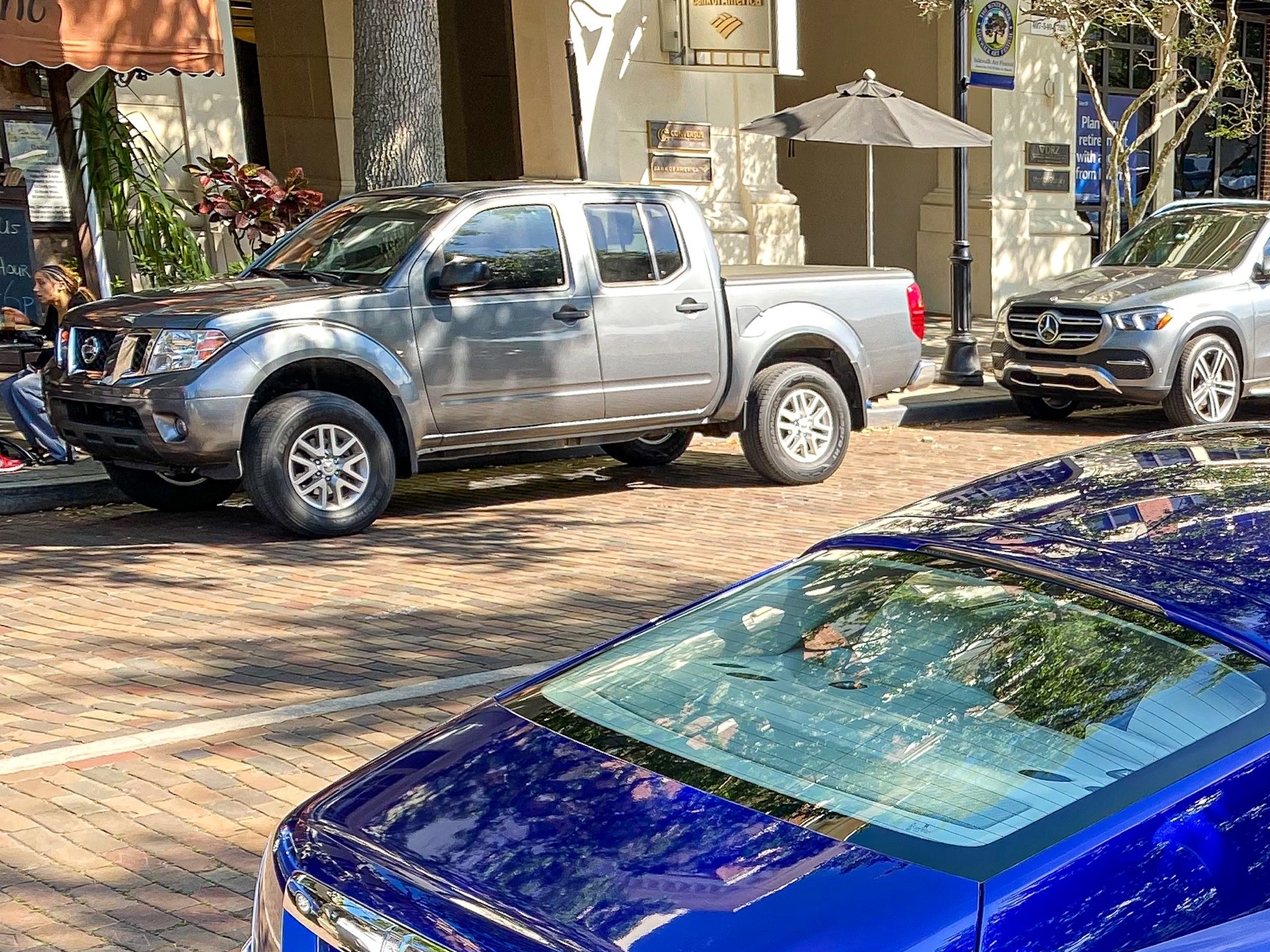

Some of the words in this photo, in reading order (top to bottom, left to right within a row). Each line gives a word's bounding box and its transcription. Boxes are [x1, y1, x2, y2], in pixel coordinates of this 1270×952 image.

[1081, 115, 1100, 129] Plan
[1076, 149, 1097, 164] with
[1076, 165, 1097, 181] from
